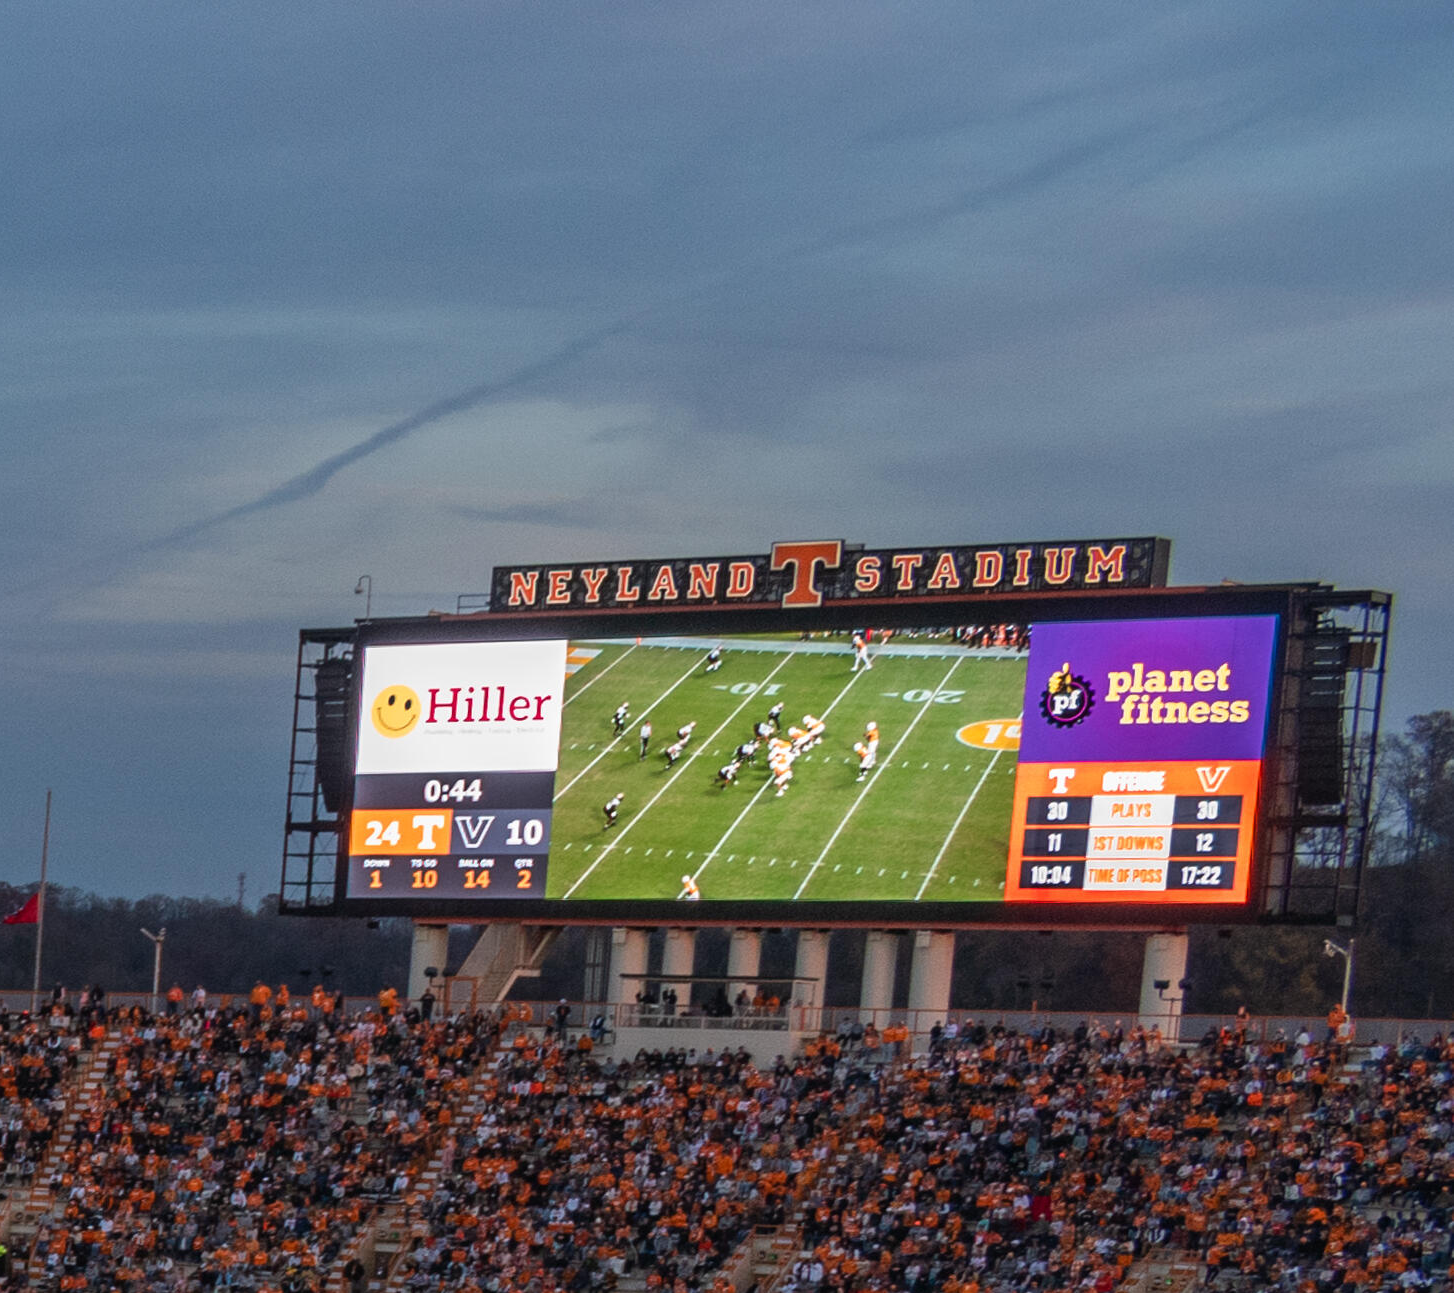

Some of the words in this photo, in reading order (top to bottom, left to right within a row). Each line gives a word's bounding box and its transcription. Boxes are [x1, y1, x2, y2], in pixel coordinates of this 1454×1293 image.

[509, 563, 755, 606] NEYLAND
[770, 541, 841, 608] T
[856, 546, 1127, 592] STADIUM
[1105, 663, 1231, 702] planet
[426, 686, 551, 723] Hiller
[1053, 690, 1081, 714] pf
[1120, 695, 1250, 724] fitness
[424, 780, 483, 802] 0:44
[1047, 802, 1068, 820] 30
[1111, 803, 1151, 818] PLAYS
[1197, 802, 1218, 820] 30
[365, 822, 400, 845] 24
[506, 821, 543, 844] 10
[1048, 834, 1063, 851] 11
[1094, 837, 1114, 850] 1ST
[1116, 836, 1163, 850] DOWNS
[1196, 834, 1213, 851] 12
[369, 870, 382, 888] 1
[412, 870, 438, 888] 10
[464, 870, 490, 888] 14
[517, 870, 531, 888] 2
[1089, 869, 1115, 883] TIME
[1116, 869, 1130, 882] OF
[1133, 869, 1163, 882] POSS
